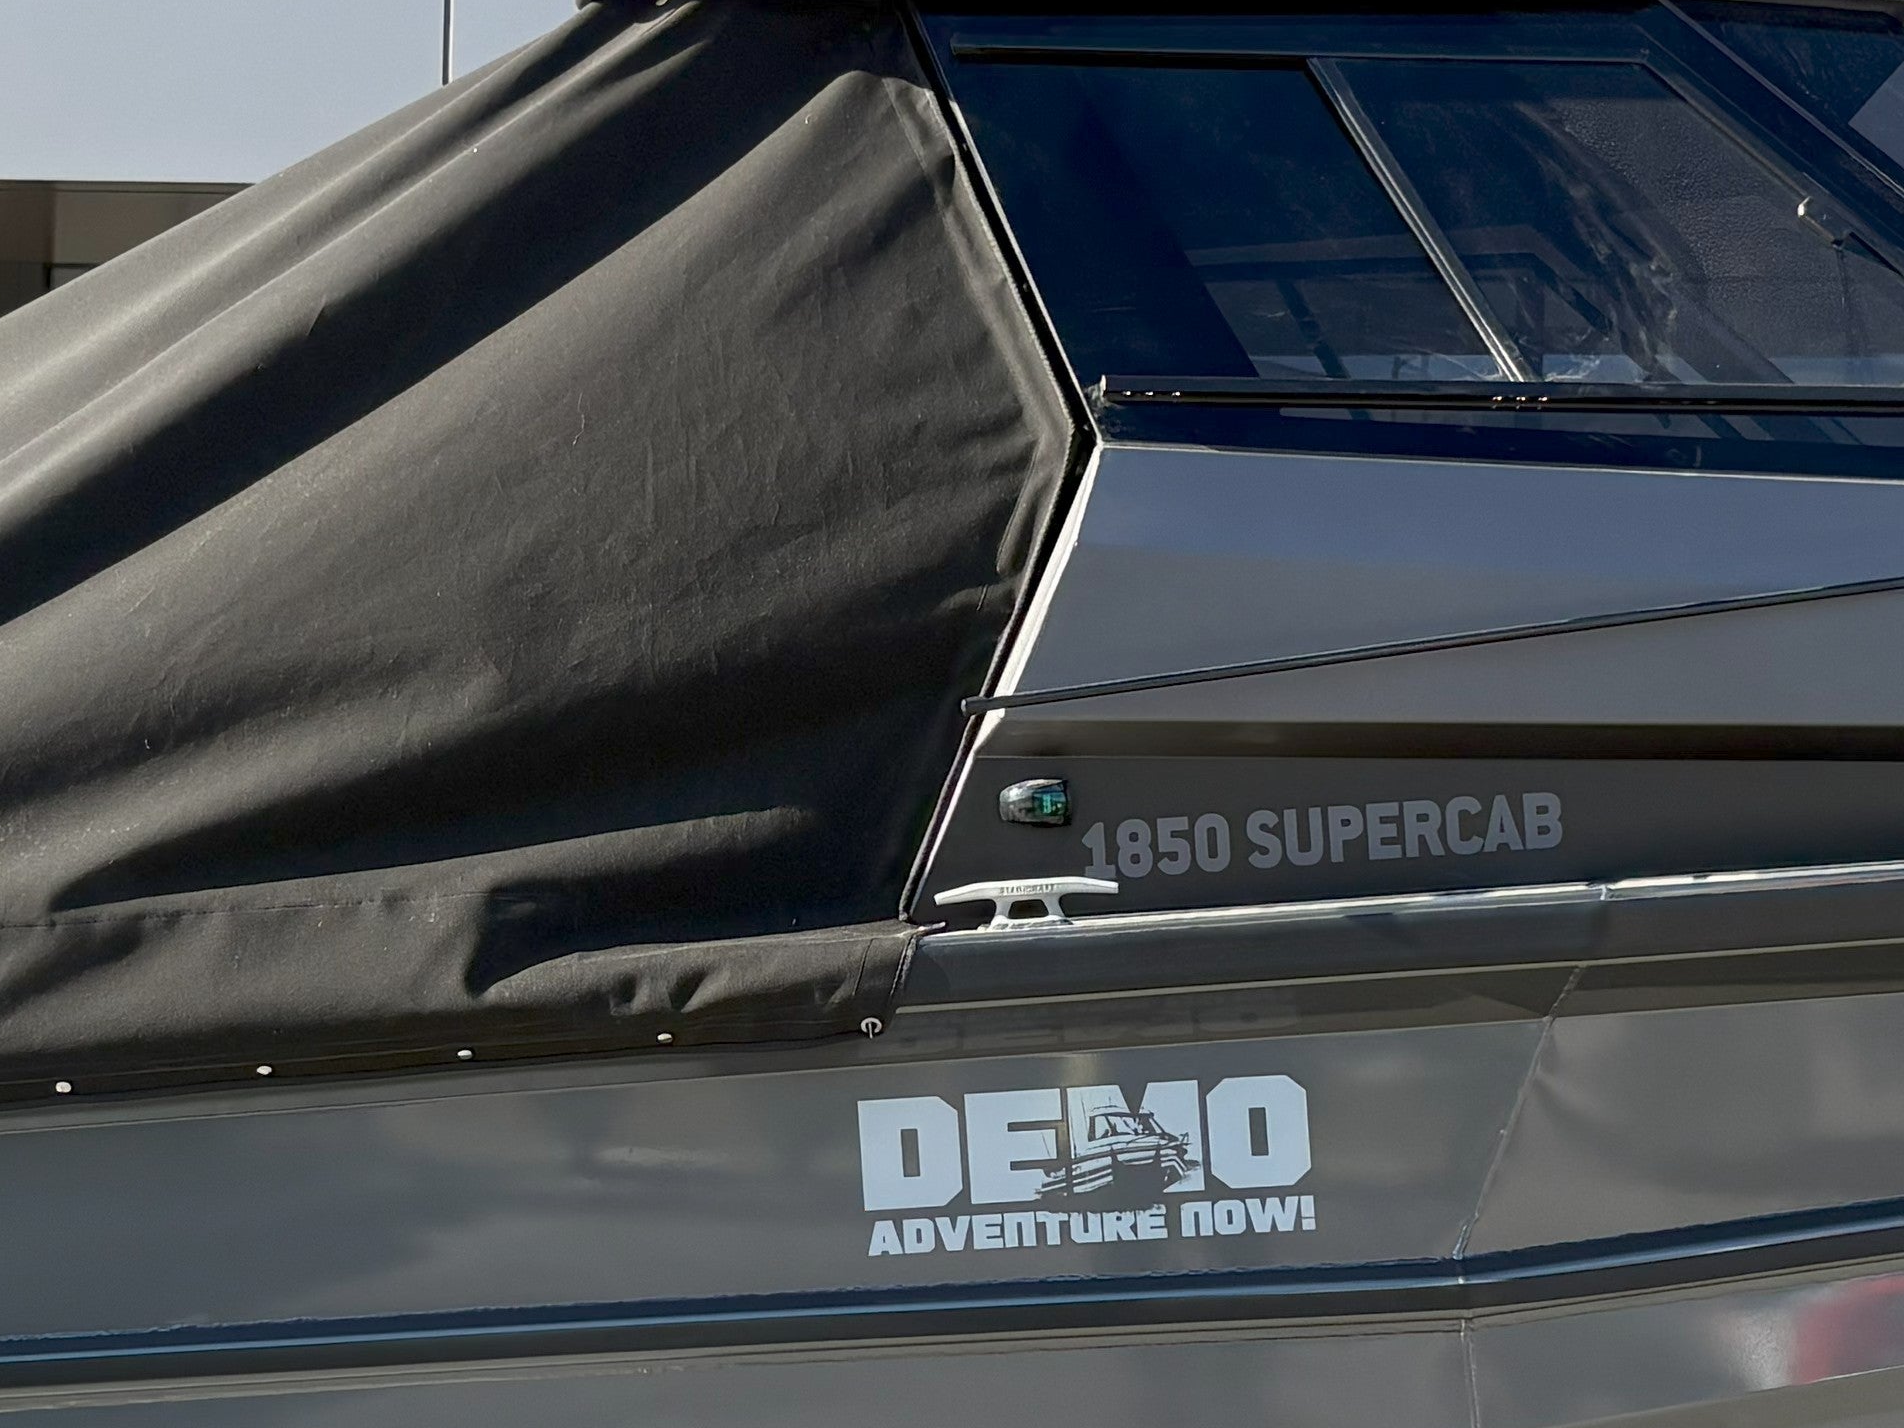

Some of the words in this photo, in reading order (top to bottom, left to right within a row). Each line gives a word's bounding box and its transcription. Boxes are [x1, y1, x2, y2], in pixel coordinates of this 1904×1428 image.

[1081, 812, 1231, 878] 1850
[1245, 791, 1564, 870] SUPERCAB
[856, 1074, 1313, 1212] DEMO
[867, 1203, 1170, 1257] ADVENTURE
[1179, 1194, 1317, 1239] NOW!
